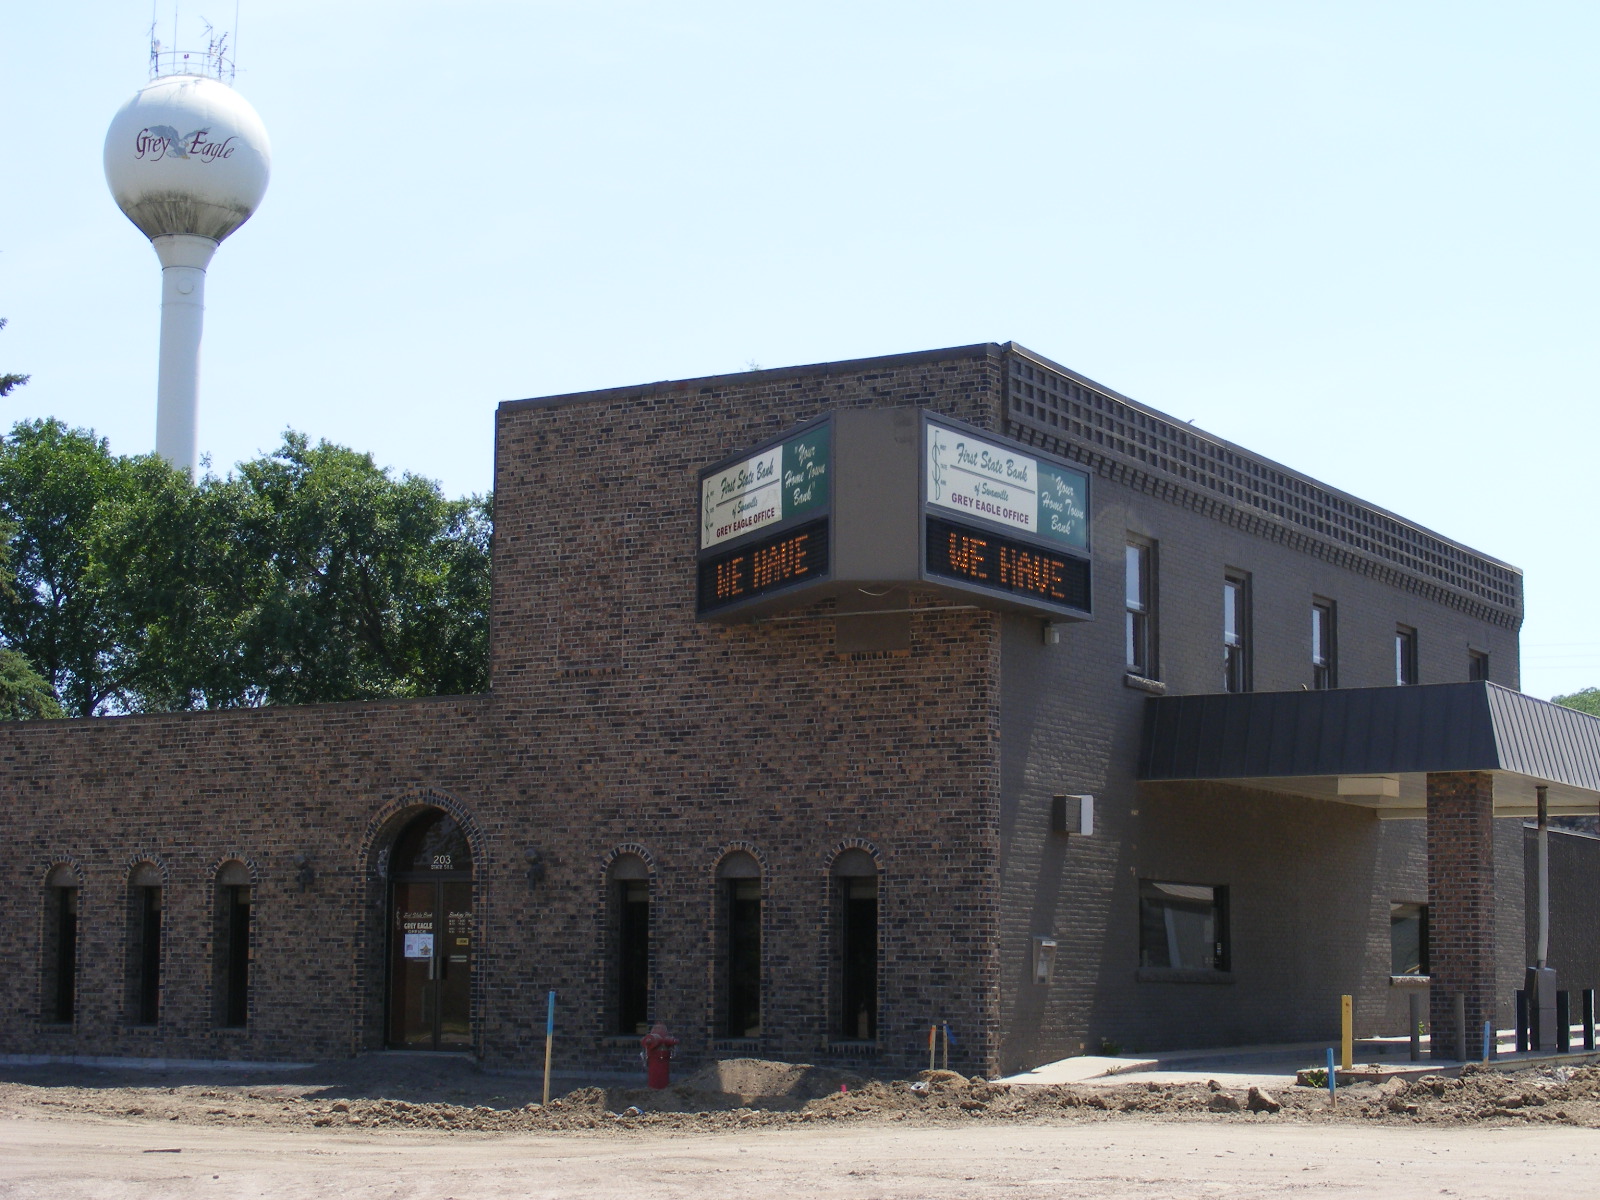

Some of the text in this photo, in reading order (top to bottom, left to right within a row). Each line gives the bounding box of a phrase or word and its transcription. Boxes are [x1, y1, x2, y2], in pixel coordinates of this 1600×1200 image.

[134, 128, 239, 164] Grey Eagle
[785, 461, 826, 488] Home Town
[956, 442, 1028, 482] First State Bank
[720, 458, 774, 499] First State Bank
[974, 483, 981, 495] of
[951, 492, 1029, 525] GREY EAGLE OFFICE
[1041, 491, 1084, 520] Home Town
[716, 507, 775, 538] GREY EAGLE OFFICE
[717, 534, 809, 598] WE HAVE
[949, 532, 1065, 598] WE HAVE
[433, 855, 451, 864] 203
[403, 922, 433, 930] GREY EAGLE
